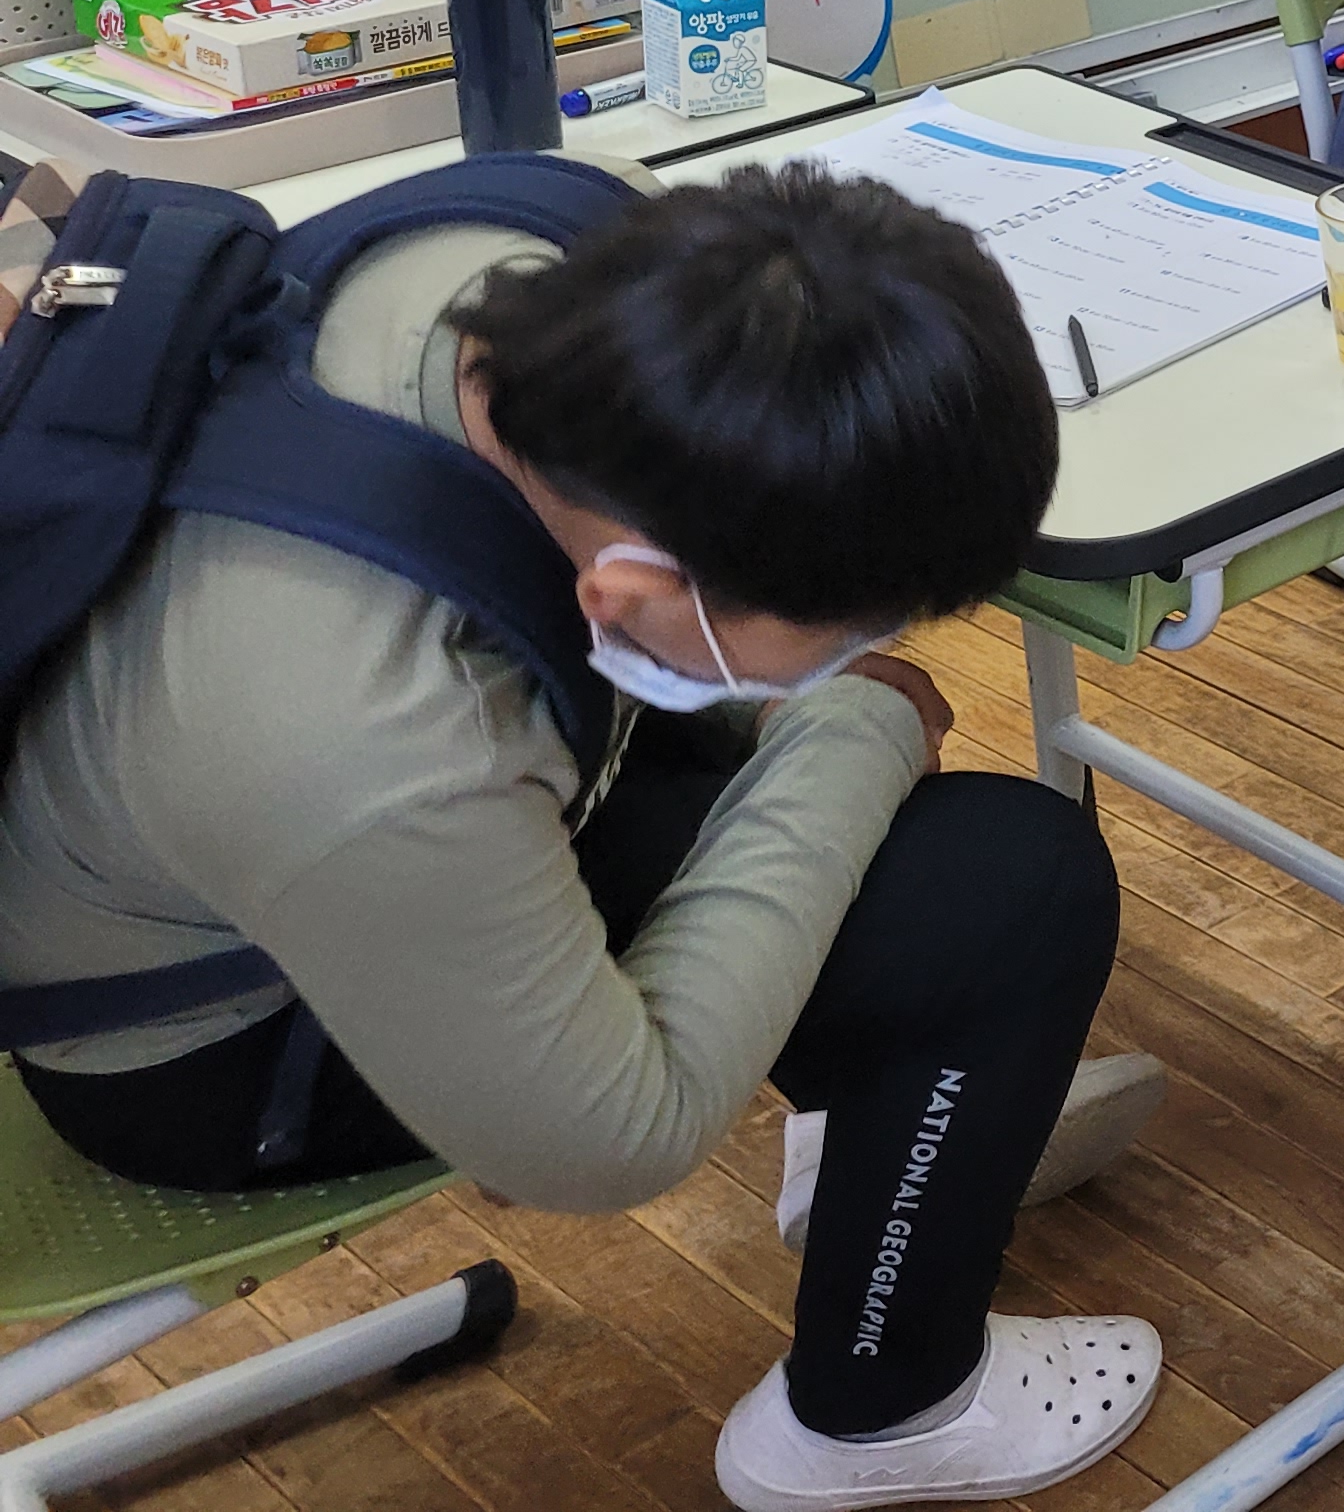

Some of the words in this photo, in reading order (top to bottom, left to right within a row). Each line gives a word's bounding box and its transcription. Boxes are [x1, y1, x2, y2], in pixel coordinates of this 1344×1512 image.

[370, 20, 432, 54] 깔끔하게
[689, 11, 726, 34] 앙팡
[890, 1067, 967, 1212] NATIONAL
[852, 1219, 914, 1357] GEOGRAPHIC
